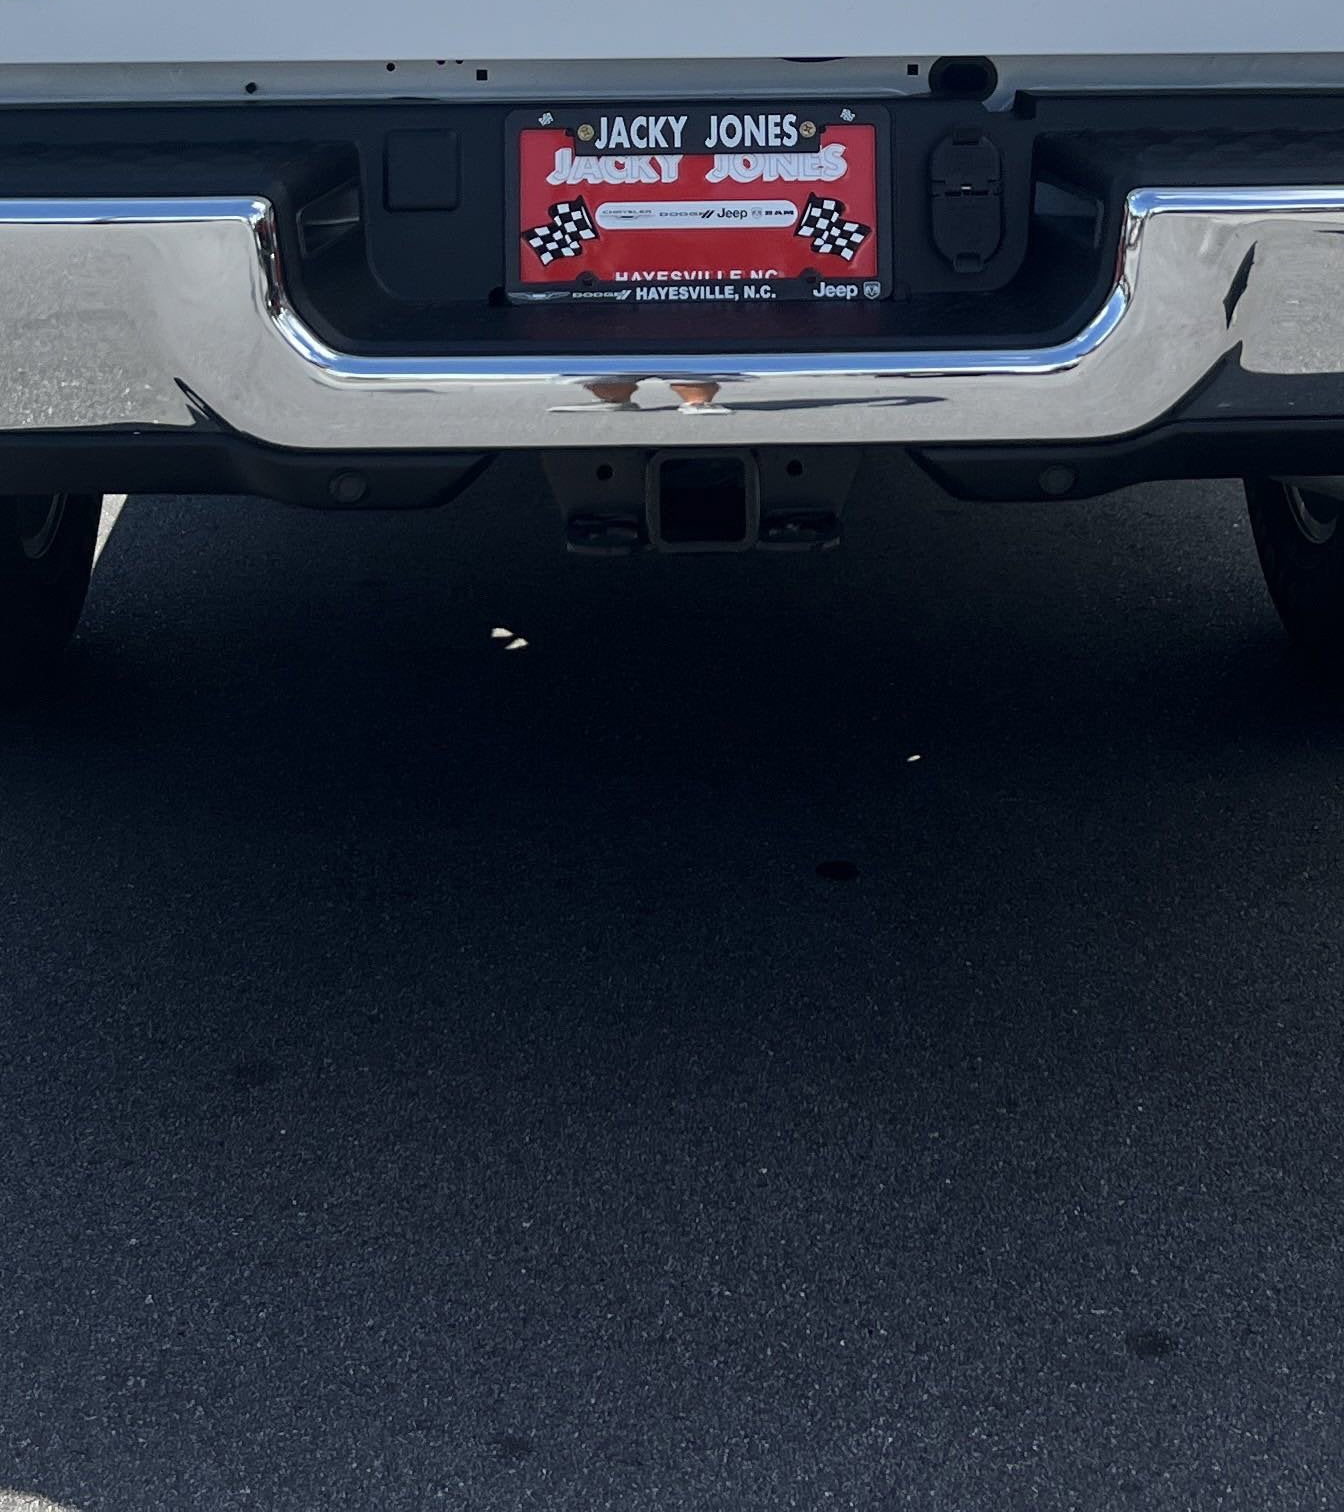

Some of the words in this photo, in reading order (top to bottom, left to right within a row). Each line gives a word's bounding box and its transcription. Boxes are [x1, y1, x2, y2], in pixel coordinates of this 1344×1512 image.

[594, 115, 687, 149] JACKY
[705, 114, 798, 148] JONES
[546, 147, 685, 186] JACKY
[705, 143, 848, 184] JONES
[717, 207, 748, 220] Jeep
[636, 285, 739, 301] HAYESVILLE,
[743, 284, 777, 299] N.C.
[813, 281, 858, 300] Jeep
